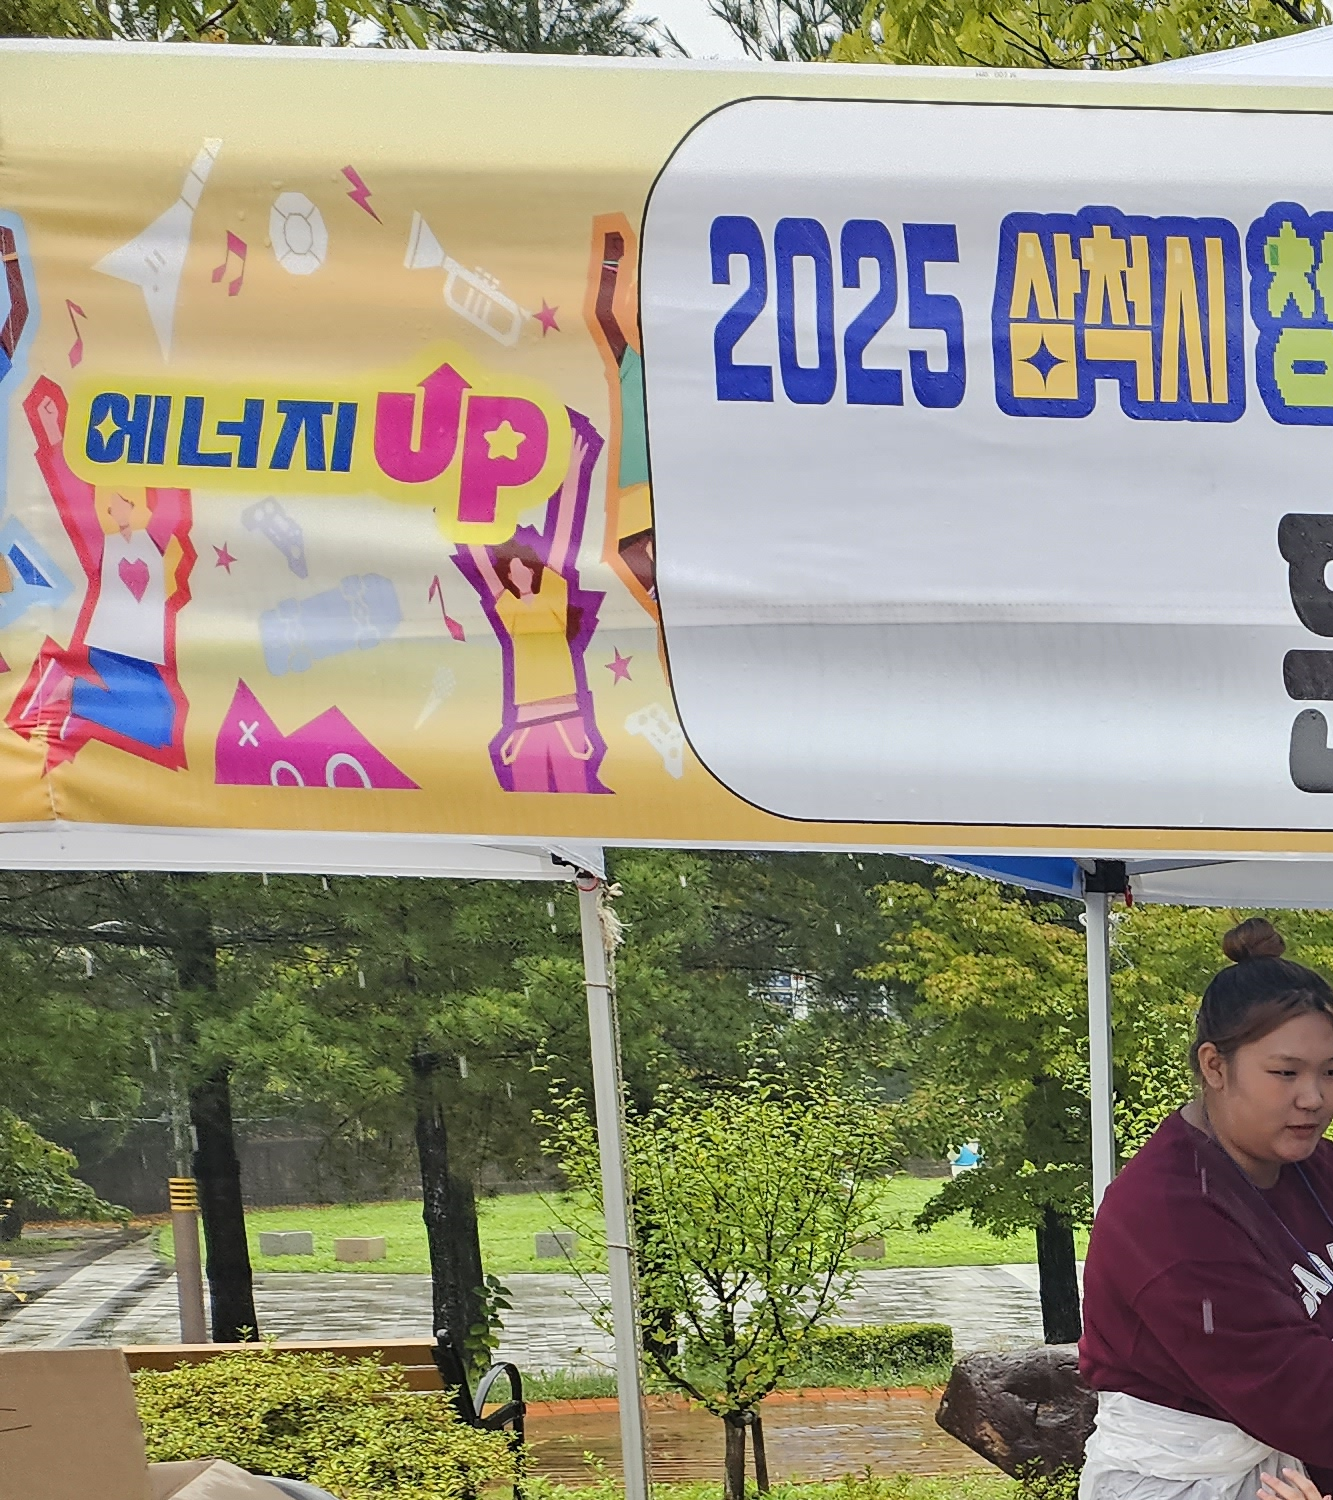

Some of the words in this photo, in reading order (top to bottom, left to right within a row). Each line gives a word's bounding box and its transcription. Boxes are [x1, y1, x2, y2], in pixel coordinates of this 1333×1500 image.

[709, 215, 967, 408] 2025
[1007, 224, 1230, 405] 삼척시
[86, 392, 358, 473] 에너지
